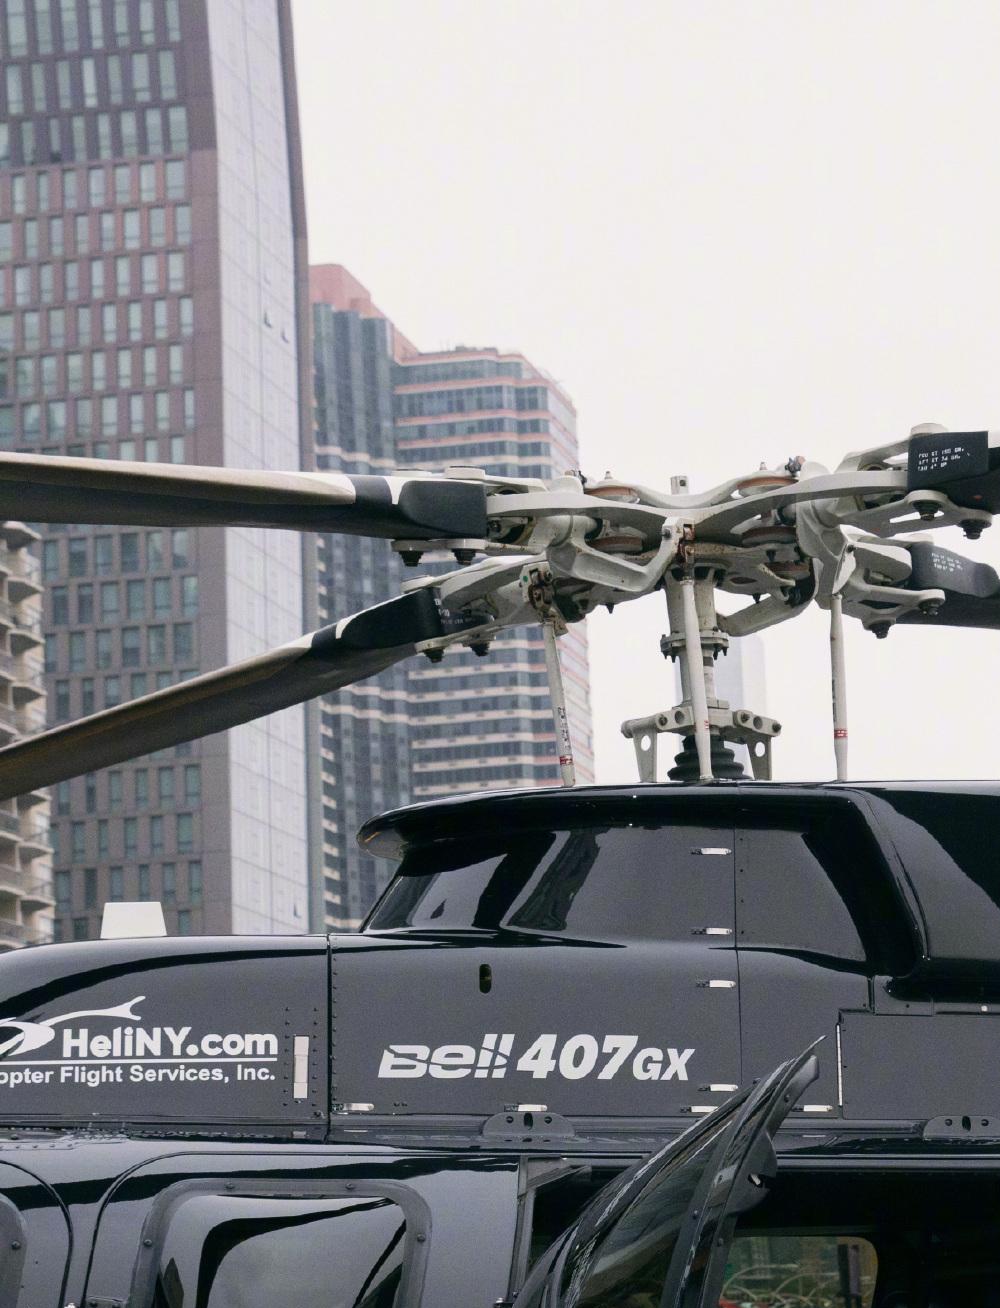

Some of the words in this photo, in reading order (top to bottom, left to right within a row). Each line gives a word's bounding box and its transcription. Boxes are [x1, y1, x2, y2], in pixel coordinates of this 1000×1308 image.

[63, 1027, 279, 1058] HeliNY.com
[378, 1034, 515, 1079] Bell
[60, 1066, 123, 1088] Flight
[129, 1064, 230, 1084] Services,
[236, 1064, 276, 1081] Inc.
